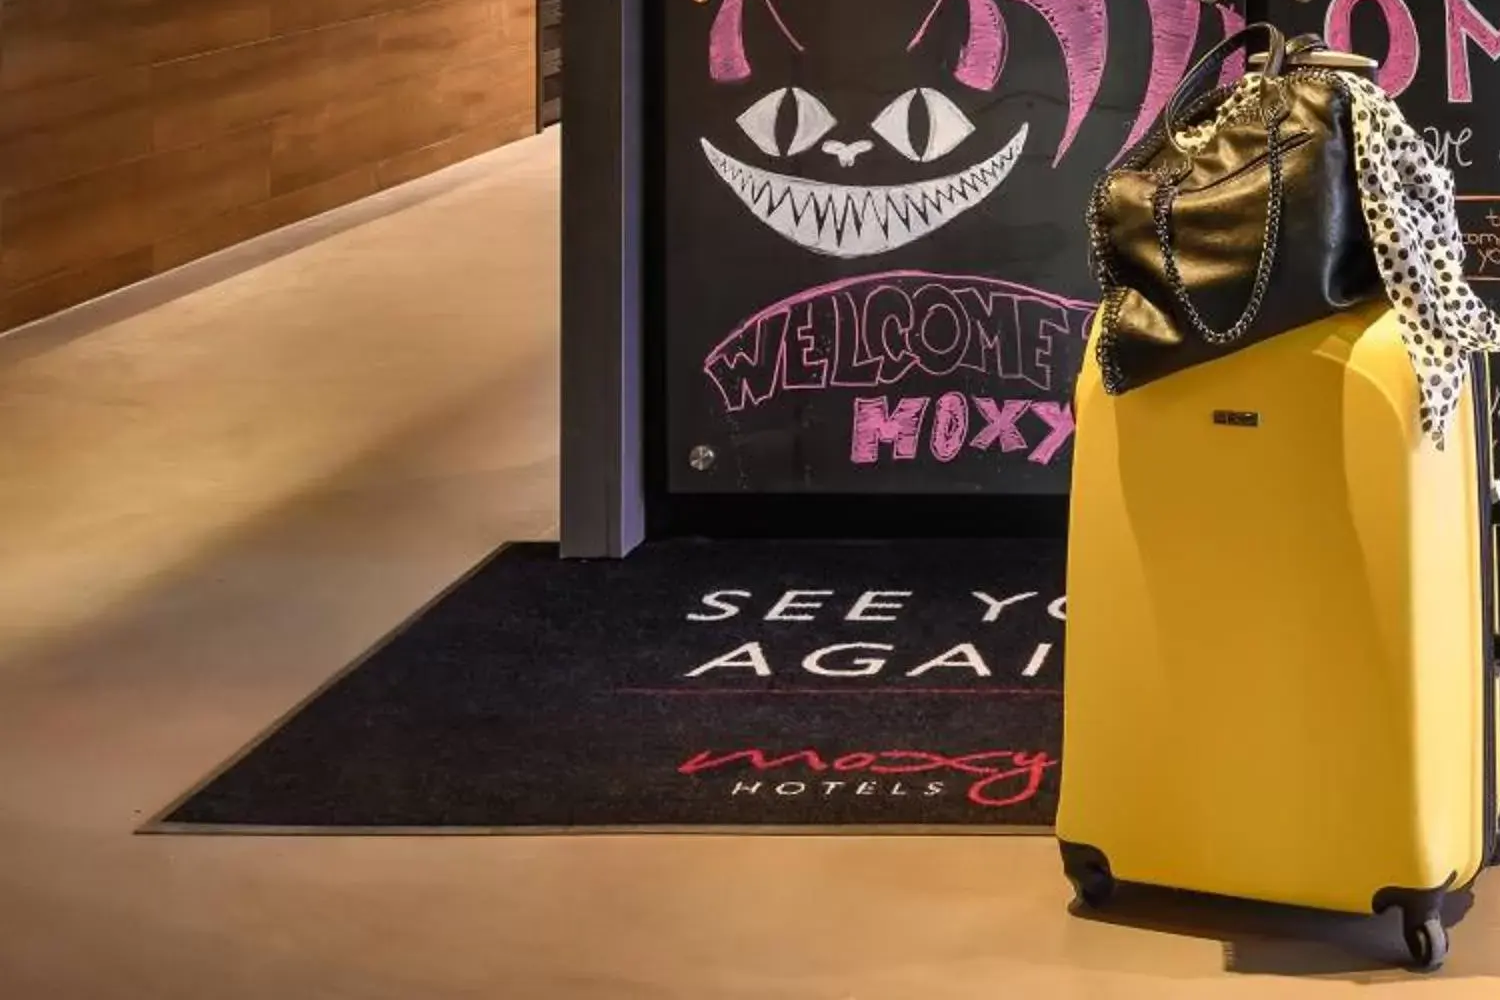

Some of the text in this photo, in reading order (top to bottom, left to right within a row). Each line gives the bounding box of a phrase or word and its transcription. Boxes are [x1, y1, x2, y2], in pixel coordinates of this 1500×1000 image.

[704, 283, 1068, 412] WELCOME
[850, 391, 1074, 465] MOXY
[686, 590, 912, 622] SEE
[685, 640, 1054, 678] AGAI
[678, 747, 1058, 807] moxy
[731, 780, 945, 796] HOTELS
